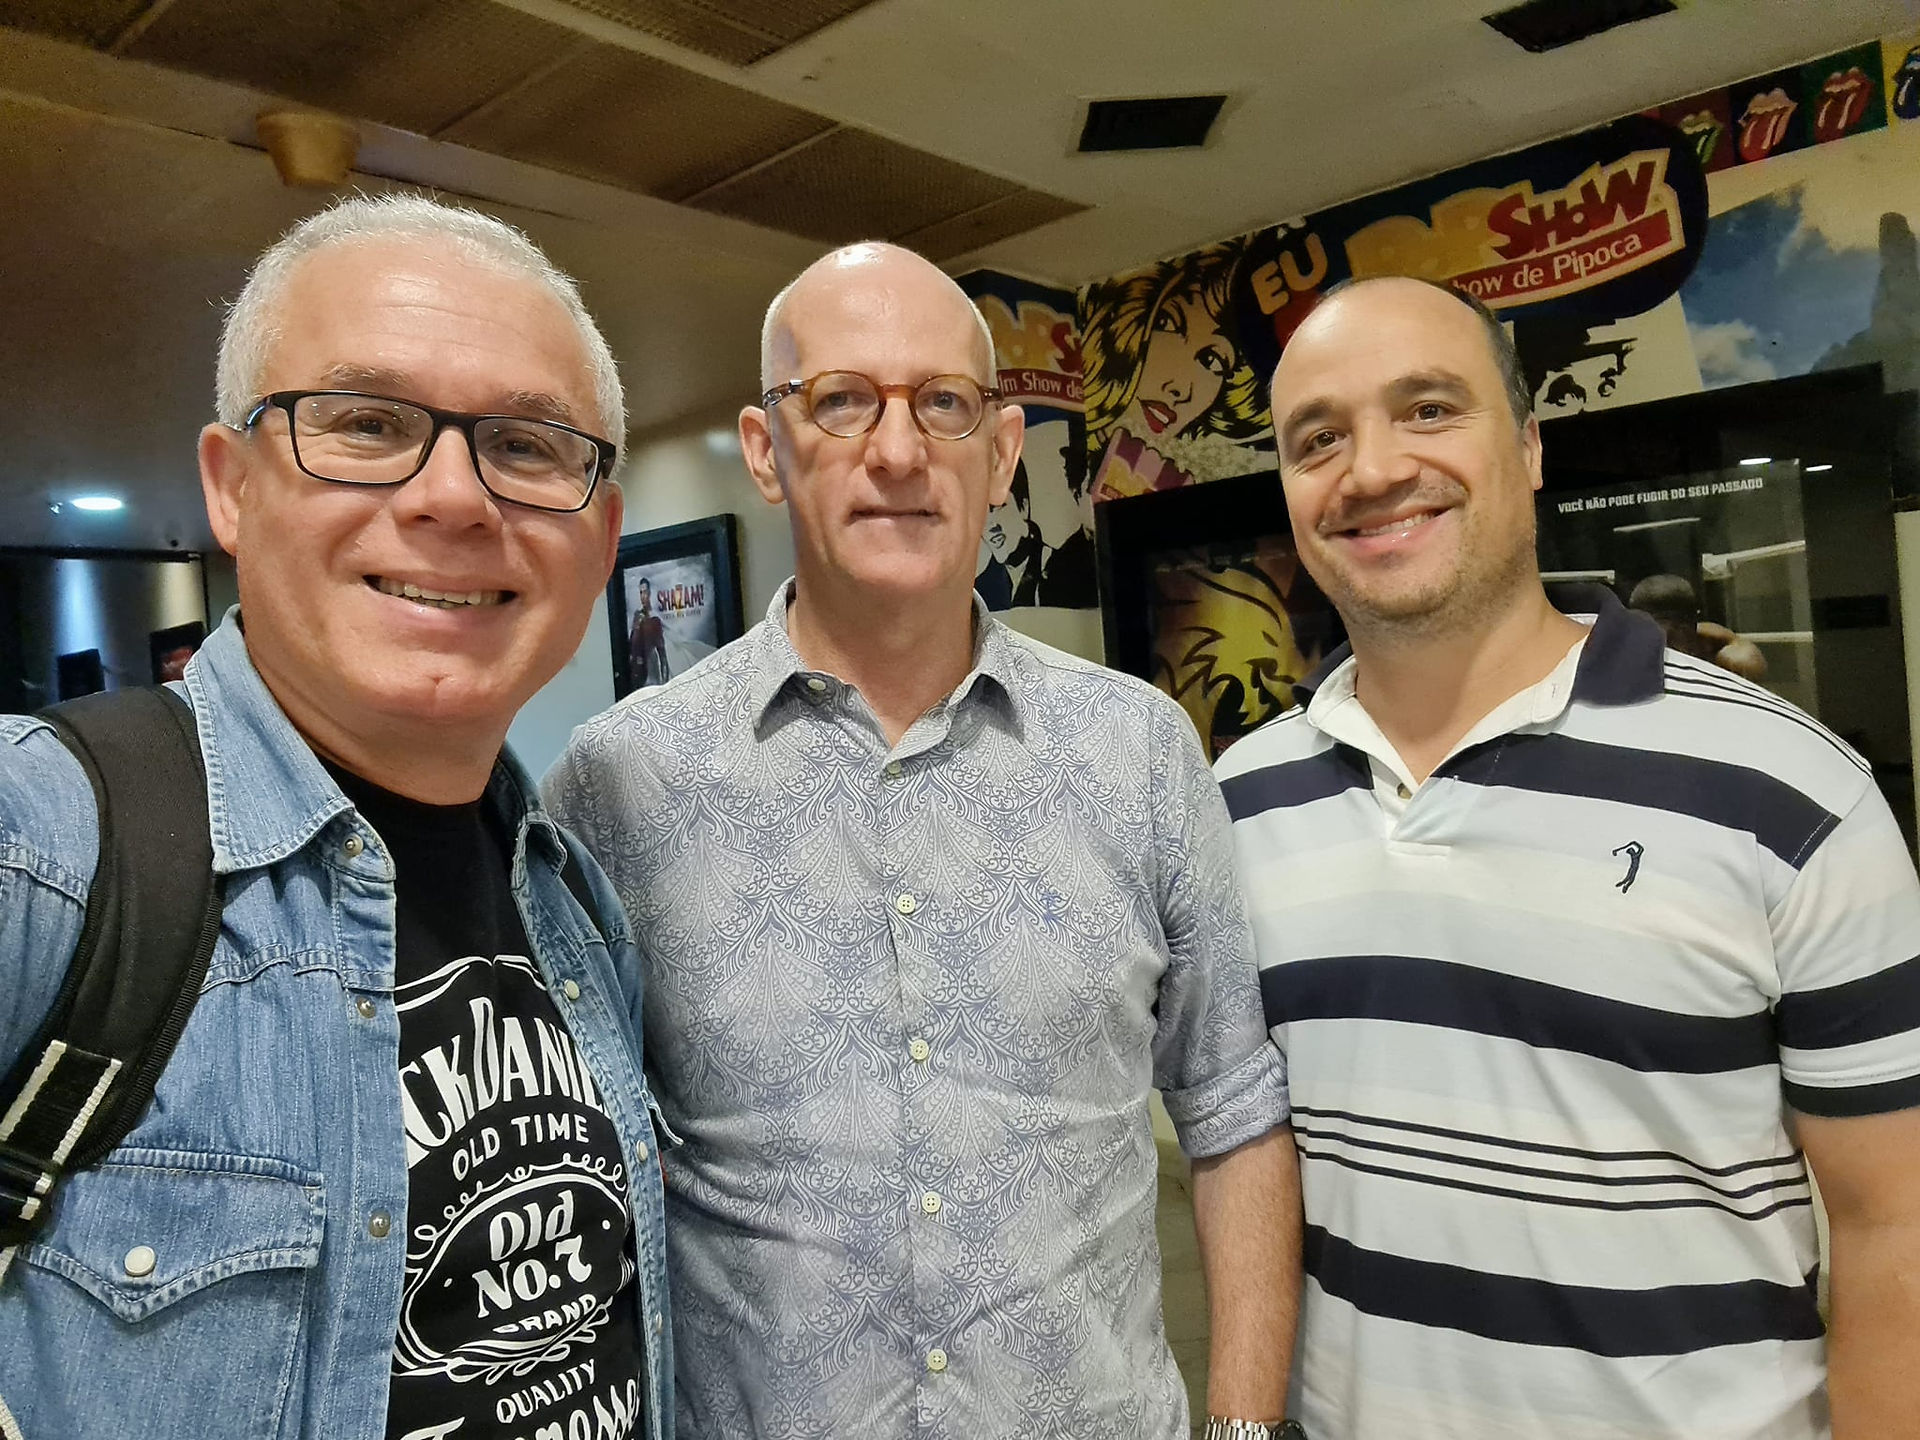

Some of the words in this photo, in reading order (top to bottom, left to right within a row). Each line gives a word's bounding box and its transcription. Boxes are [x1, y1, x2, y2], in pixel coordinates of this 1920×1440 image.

[1251, 232, 1328, 315] EU
[1513, 263, 1544, 289] de
[1553, 231, 1642, 280] Pipoca
[1022, 371, 1062, 393] Show
[1558, 498, 1584, 514] VOCÊ
[1585, 497, 1607, 510] NÃO
[1608, 493, 1635, 508] PODE
[1636, 489, 1670, 504] FUGIR
[1671, 487, 1686, 500] DO
[1688, 485, 1710, 498] SEU
[1711, 477, 1764, 495] PASSADO
[452, 1127, 500, 1181] OLD
[511, 1112, 590, 1146] TIME
[489, 1189, 574, 1262] Old
[496, 1358, 595, 1424] QUALITY
